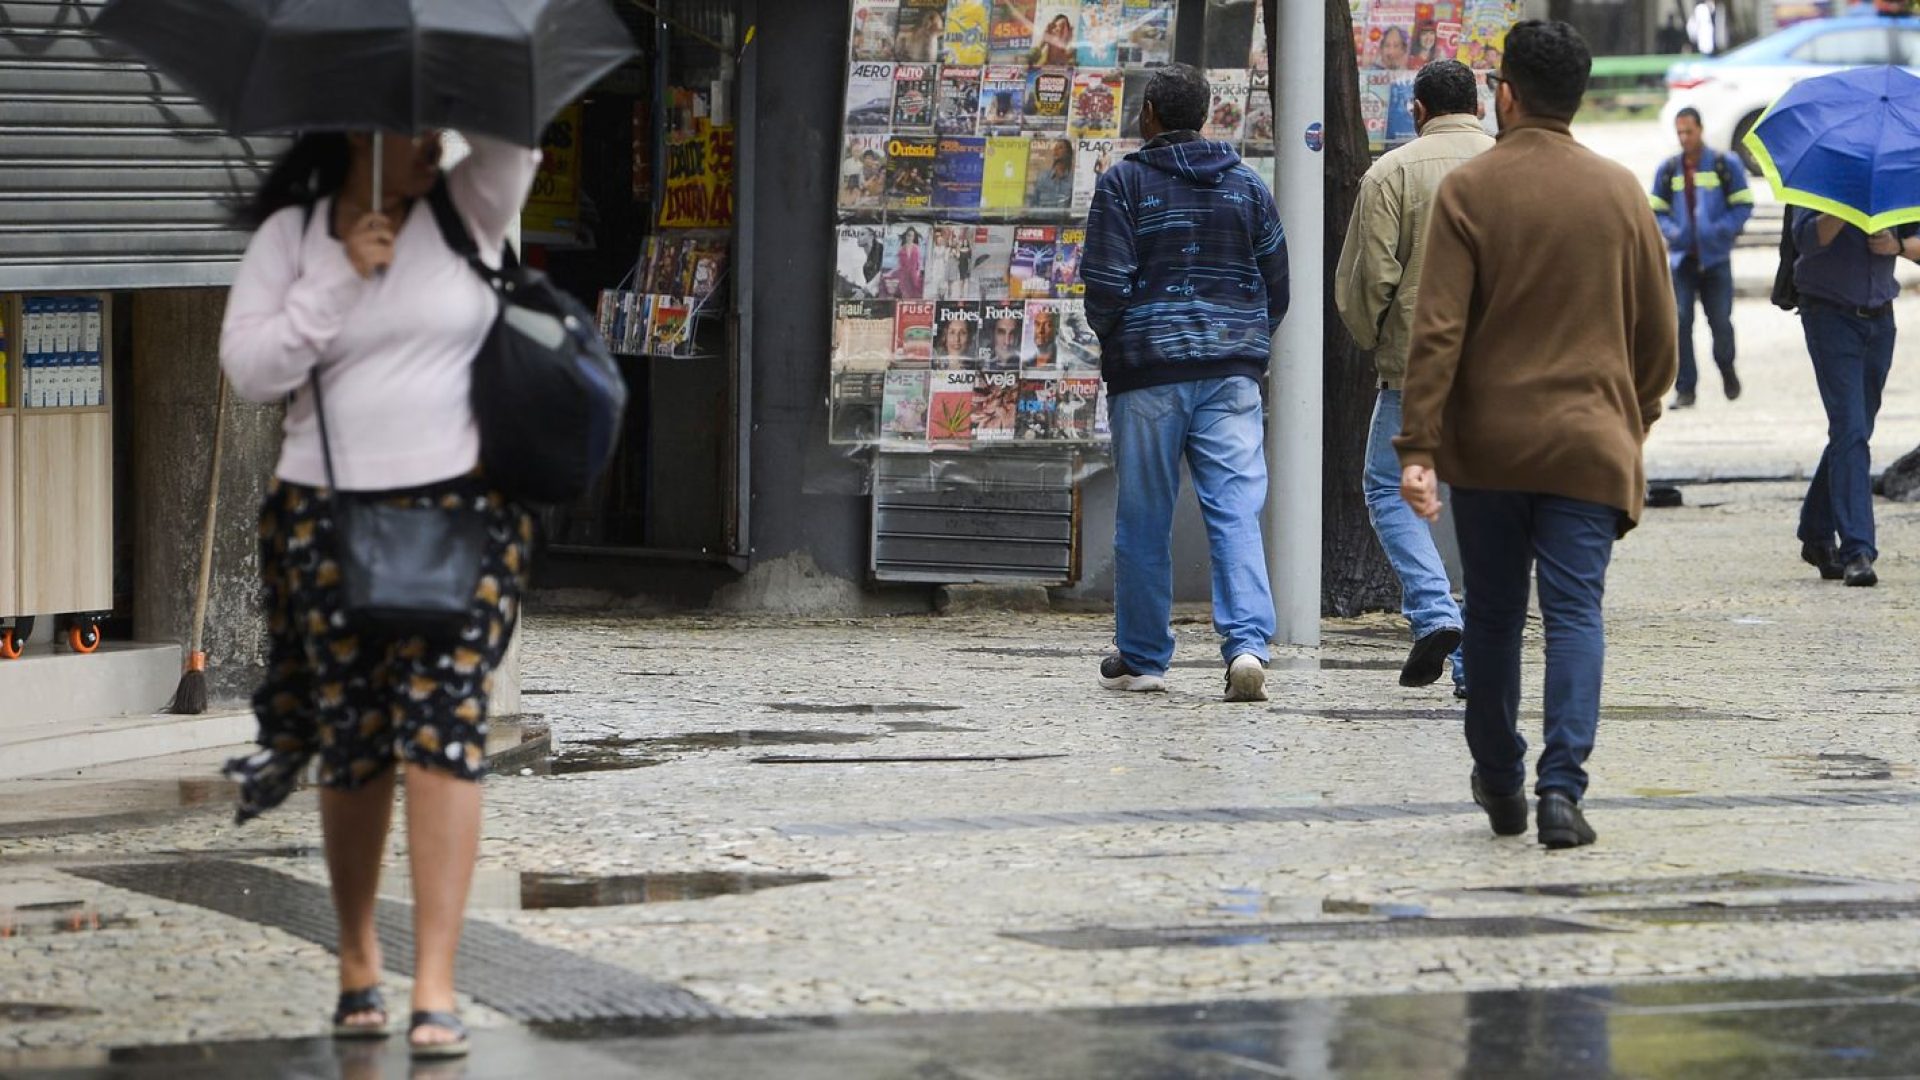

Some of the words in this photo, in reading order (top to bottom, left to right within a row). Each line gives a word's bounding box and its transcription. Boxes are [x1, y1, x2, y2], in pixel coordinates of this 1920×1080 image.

[852, 64, 891, 78] AERO
[896, 66, 924, 78] AUTO
[1209, 83, 1250, 97] oração
[1017, 227, 1044, 240] SUPER
[902, 304, 931, 314] FUSC
[940, 307, 980, 321] Forbes
[985, 305, 1024, 320] Forbes
[984, 371, 1015, 388] veja
